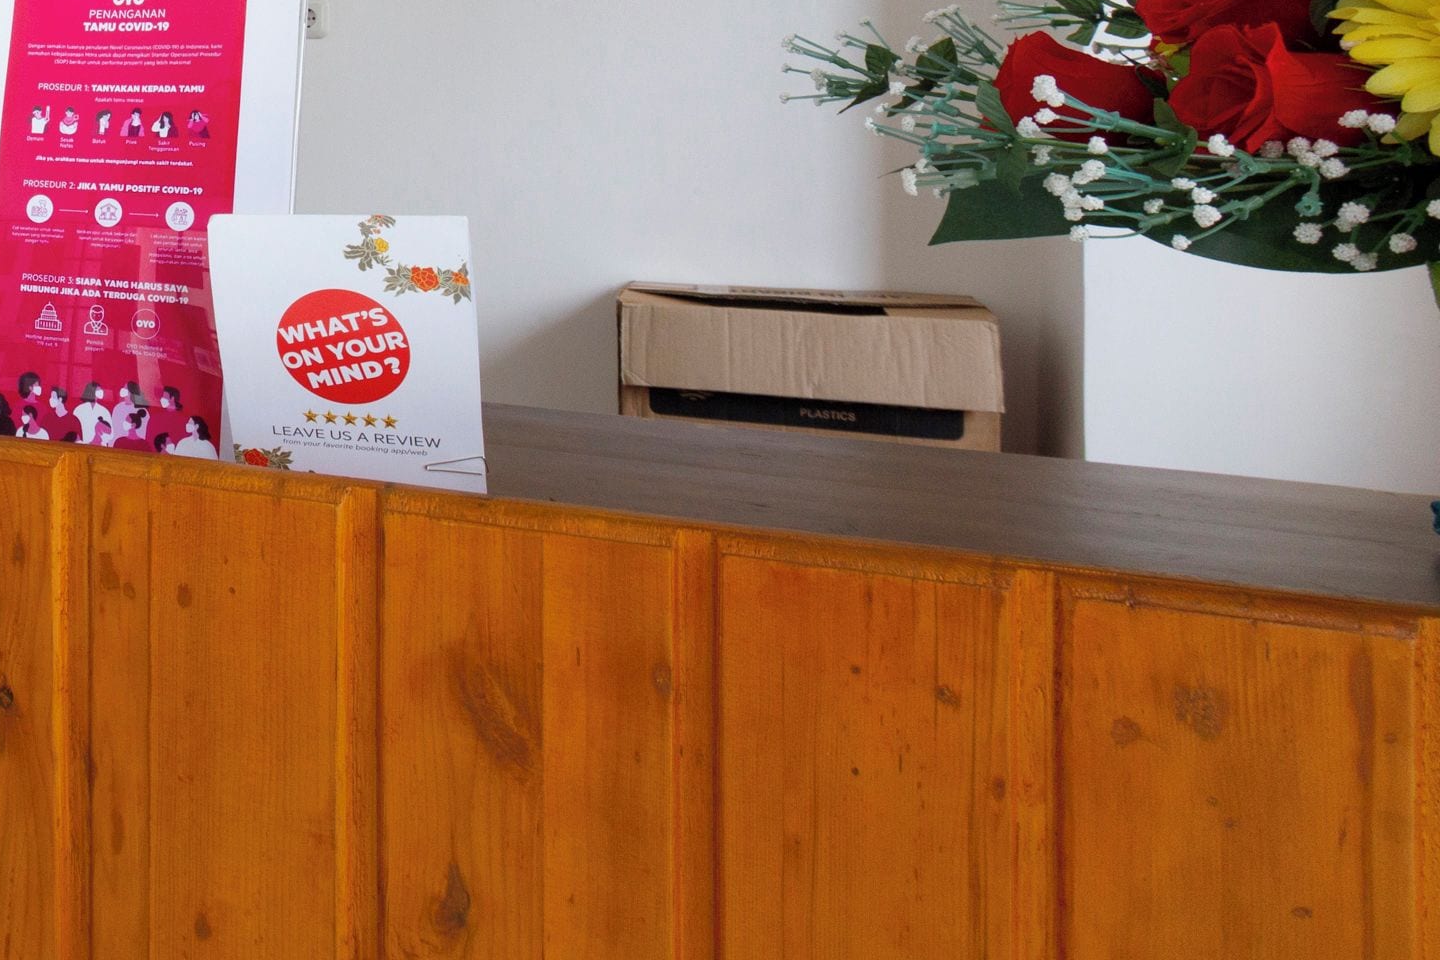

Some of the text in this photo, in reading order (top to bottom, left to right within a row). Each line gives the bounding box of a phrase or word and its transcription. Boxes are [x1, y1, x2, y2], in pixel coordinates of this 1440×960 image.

[89, 9, 166, 19] PENANGANAN
[83, 21, 170, 32] TAMU COVID-19
[38, 82, 82, 92] PROSEDUR
[91, 84, 141, 93] TANYAKAN
[142, 85, 176, 93] KEPADA
[178, 85, 205, 93] TAMU
[23, 179, 204, 195] PROSEDUR 2: JIKA TAMU POSITIF COVID-19
[22, 272, 66, 284] PROSEDUR
[74, 277, 102, 286] SIAPA
[104, 279, 129, 289] YANG
[130, 281, 162, 292] HARUS
[163, 284, 188, 294] SAYA
[20, 284, 189, 304] HUBUNGI JIKA ADA TERDUGA COVID-19
[136, 318, 156, 328] OYO
[278, 308, 388, 344] WHAT'S
[282, 332, 408, 369] ON YOUR
[306, 356, 401, 390] MIND?
[800, 408, 857, 422] PLASTICS
[272, 426, 441, 449] LEAVE US A REVIEW
[302, 440, 322, 448] your
[323, 441, 354, 450] favorite
[356, 444, 388, 454] booking
[390, 447, 429, 456] app/web
